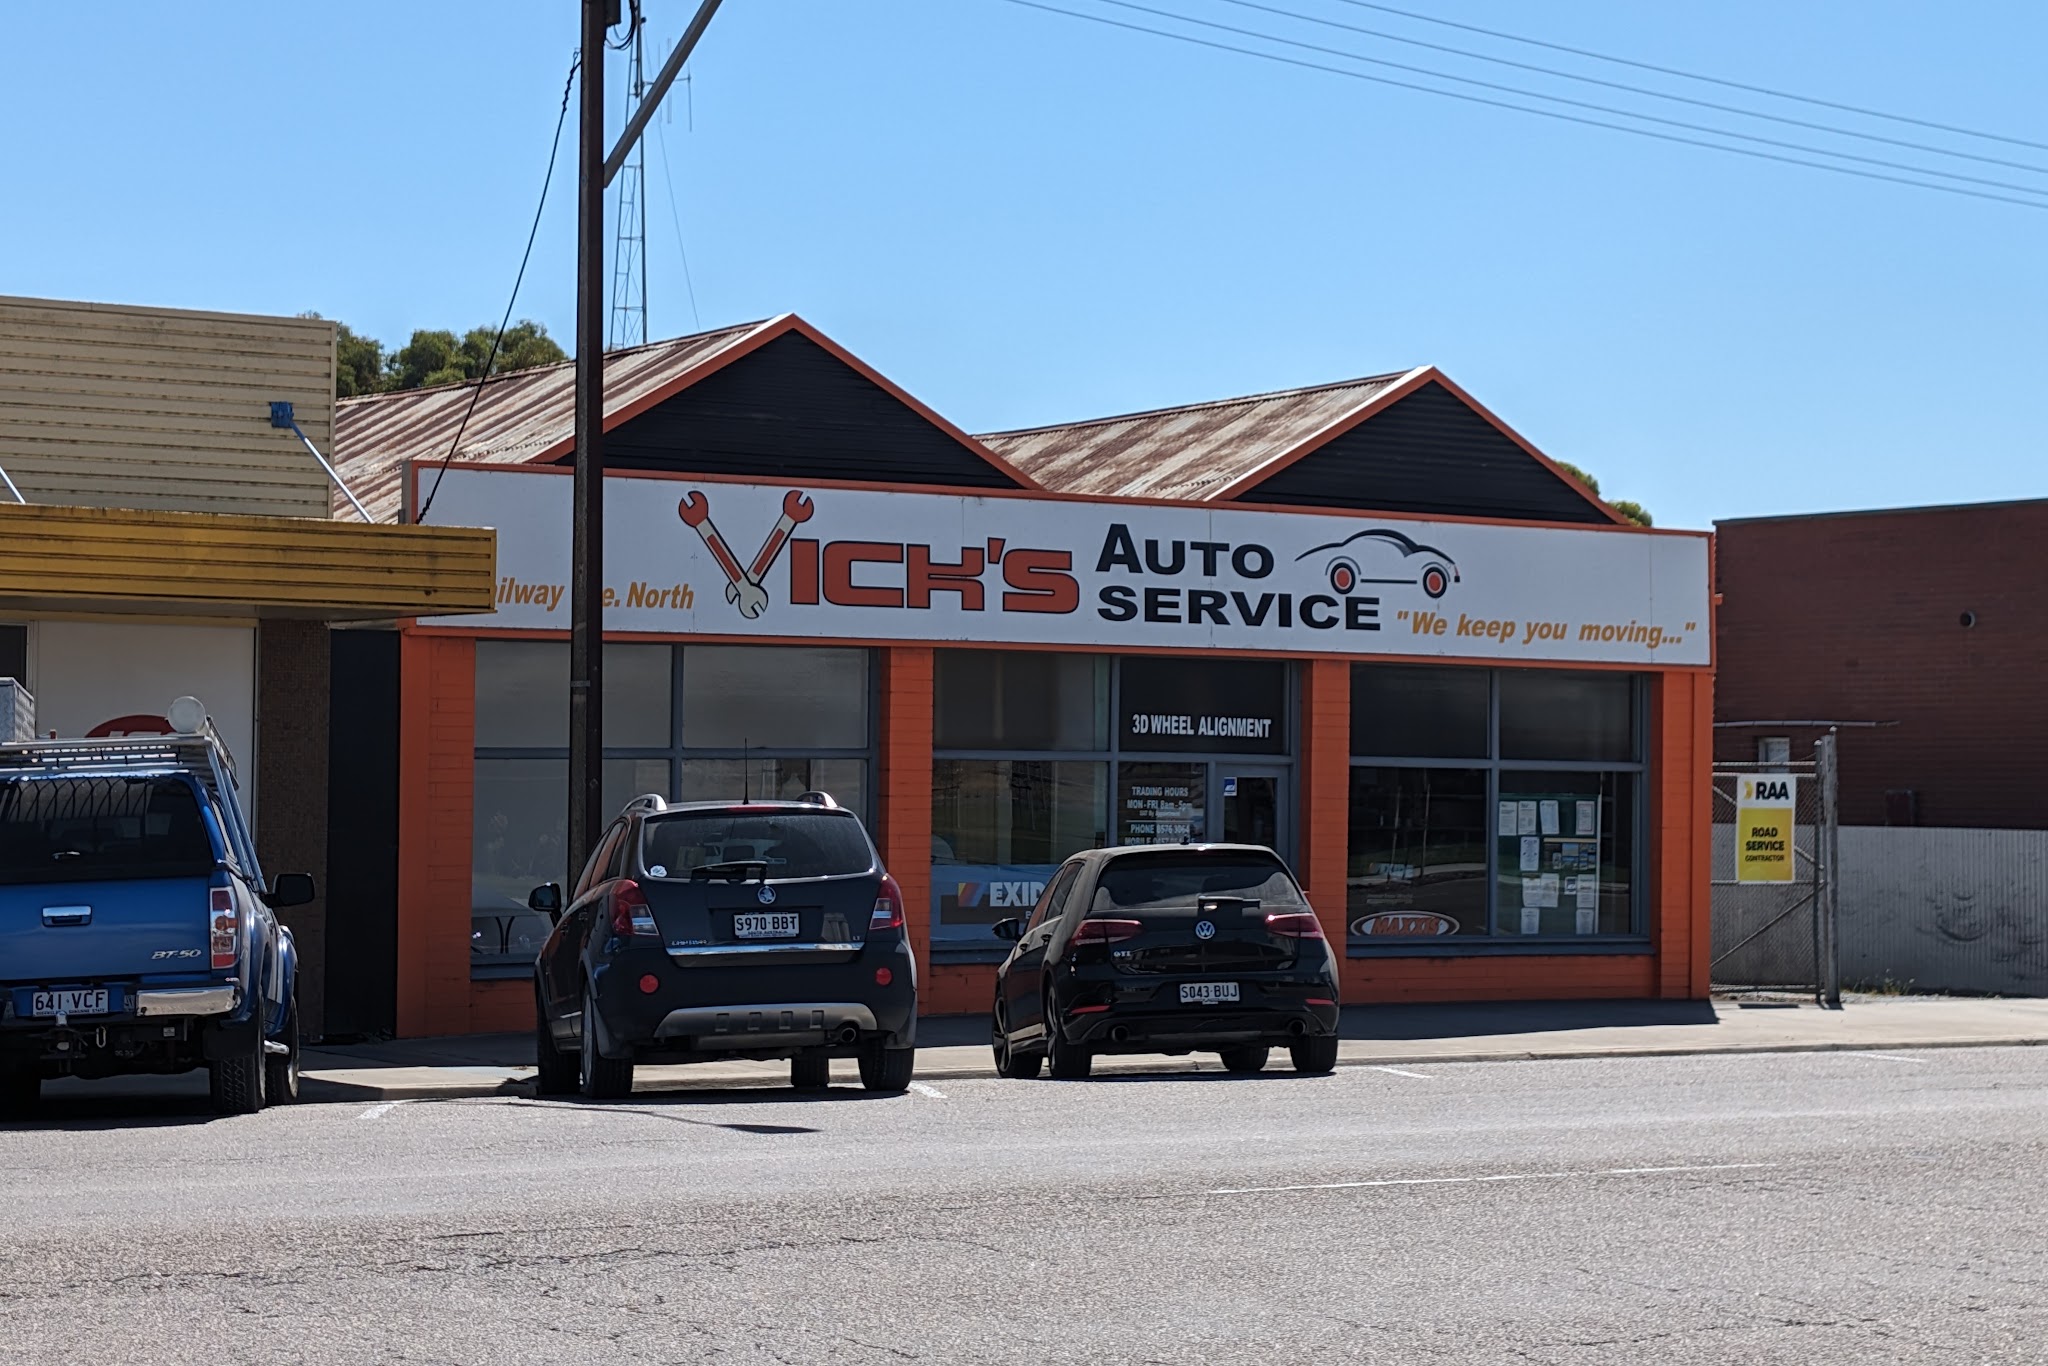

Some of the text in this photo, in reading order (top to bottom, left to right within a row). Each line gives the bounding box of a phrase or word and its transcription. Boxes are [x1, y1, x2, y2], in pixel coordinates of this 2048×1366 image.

[1095, 523, 1275, 579] AUTO
[495, 577, 565, 612] ilway
[626, 581, 695, 610] North
[1097, 585, 1381, 631] SERVICE
[1456, 614, 1516, 644] keep
[1522, 621, 1568, 645] you
[1132, 714, 1272, 738] 3D WHEEL ALIGNMENT
[1131, 786, 1189, 797] TRADING HOURS
[1755, 781, 1790, 801] RAA
[1130, 824, 1155, 834] PHONE
[1751, 827, 1779, 838] ROAD
[1745, 841, 1785, 852] SERVICE
[1745, 854, 1785, 862] CONTRACTOR
[989, 881, 1047, 907] EXID
[151, 948, 202, 960] BT-50
